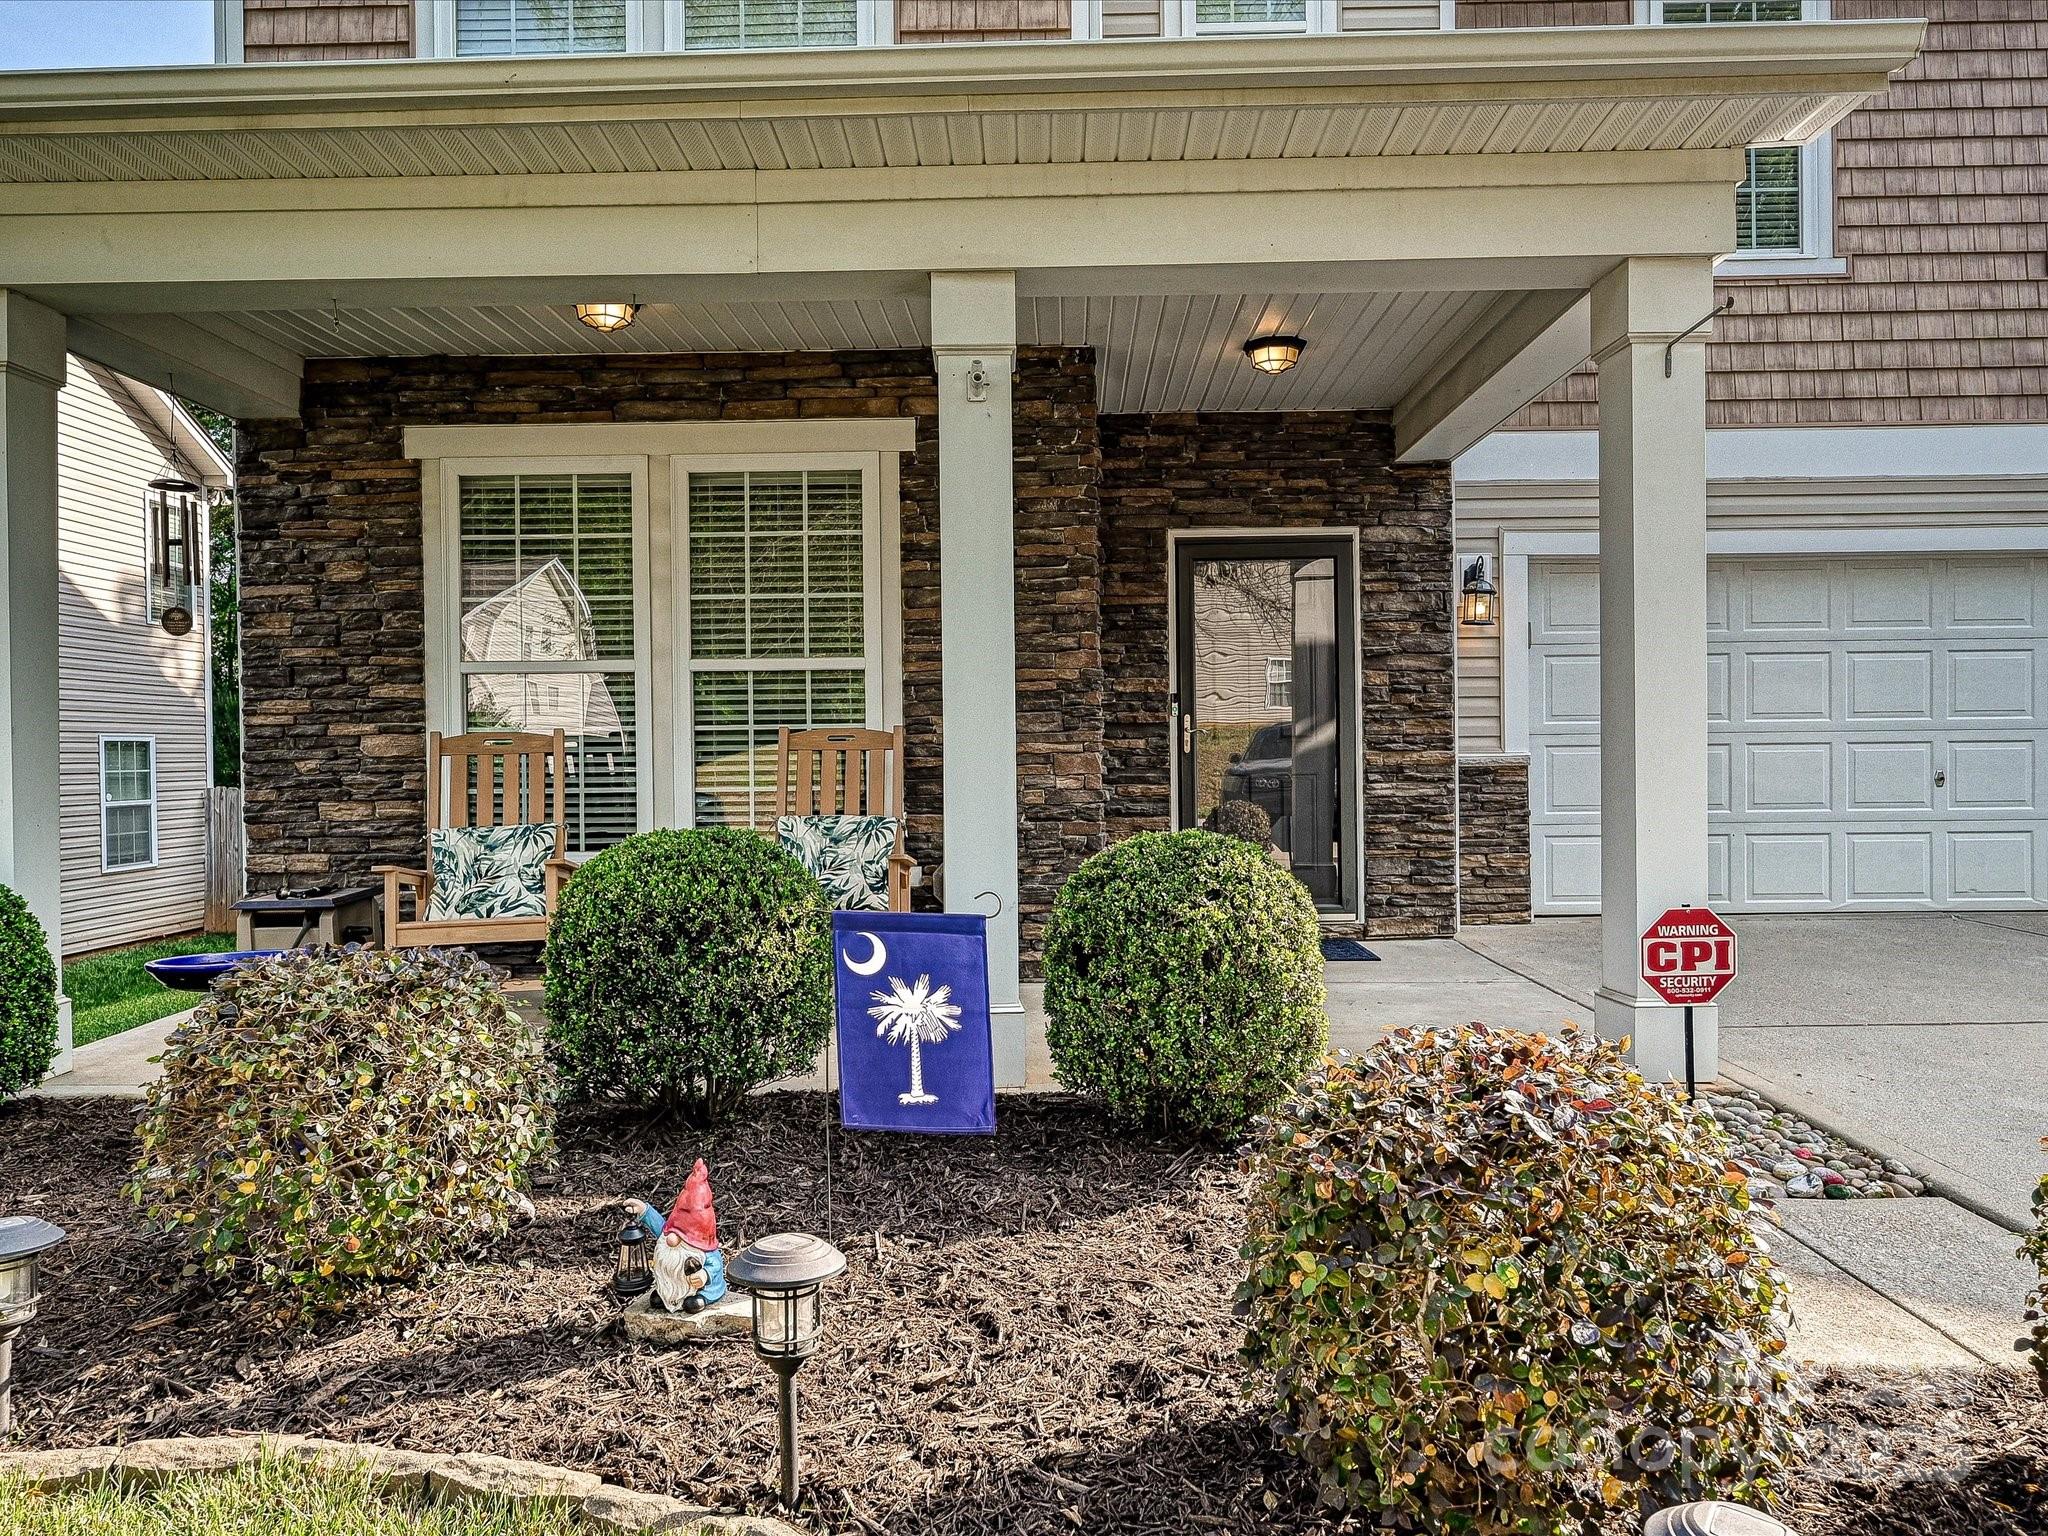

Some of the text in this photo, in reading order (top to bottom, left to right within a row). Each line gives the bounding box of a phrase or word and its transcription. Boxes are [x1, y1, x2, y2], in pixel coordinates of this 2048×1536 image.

[1657, 924, 1719, 937] WARNING
[1646, 940, 1731, 973] CPI
[1659, 976, 1718, 988] SECURITY
